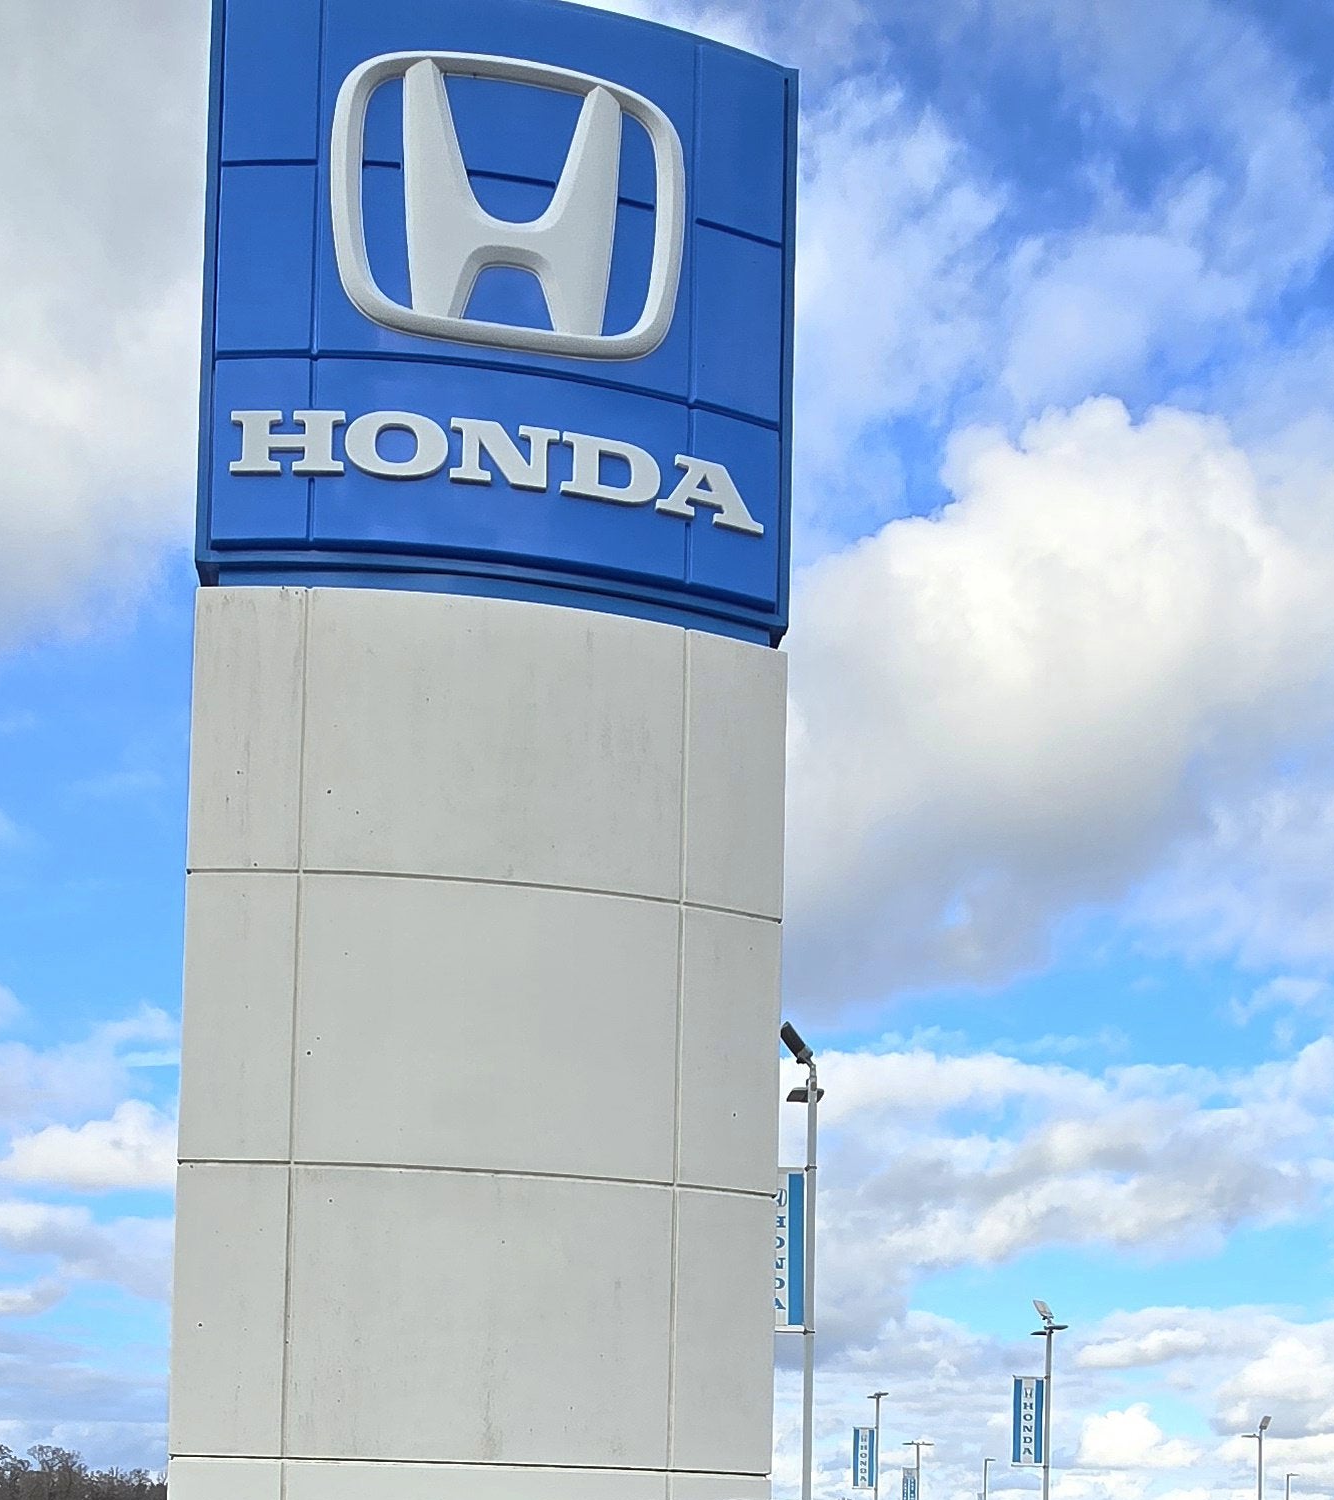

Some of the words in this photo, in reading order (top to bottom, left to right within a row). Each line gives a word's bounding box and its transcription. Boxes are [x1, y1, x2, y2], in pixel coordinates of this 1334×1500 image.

[229, 410, 765, 536] HONDA
[1022, 1402, 1034, 1456] HONDA
[859, 1444, 868, 1482] HONDA
